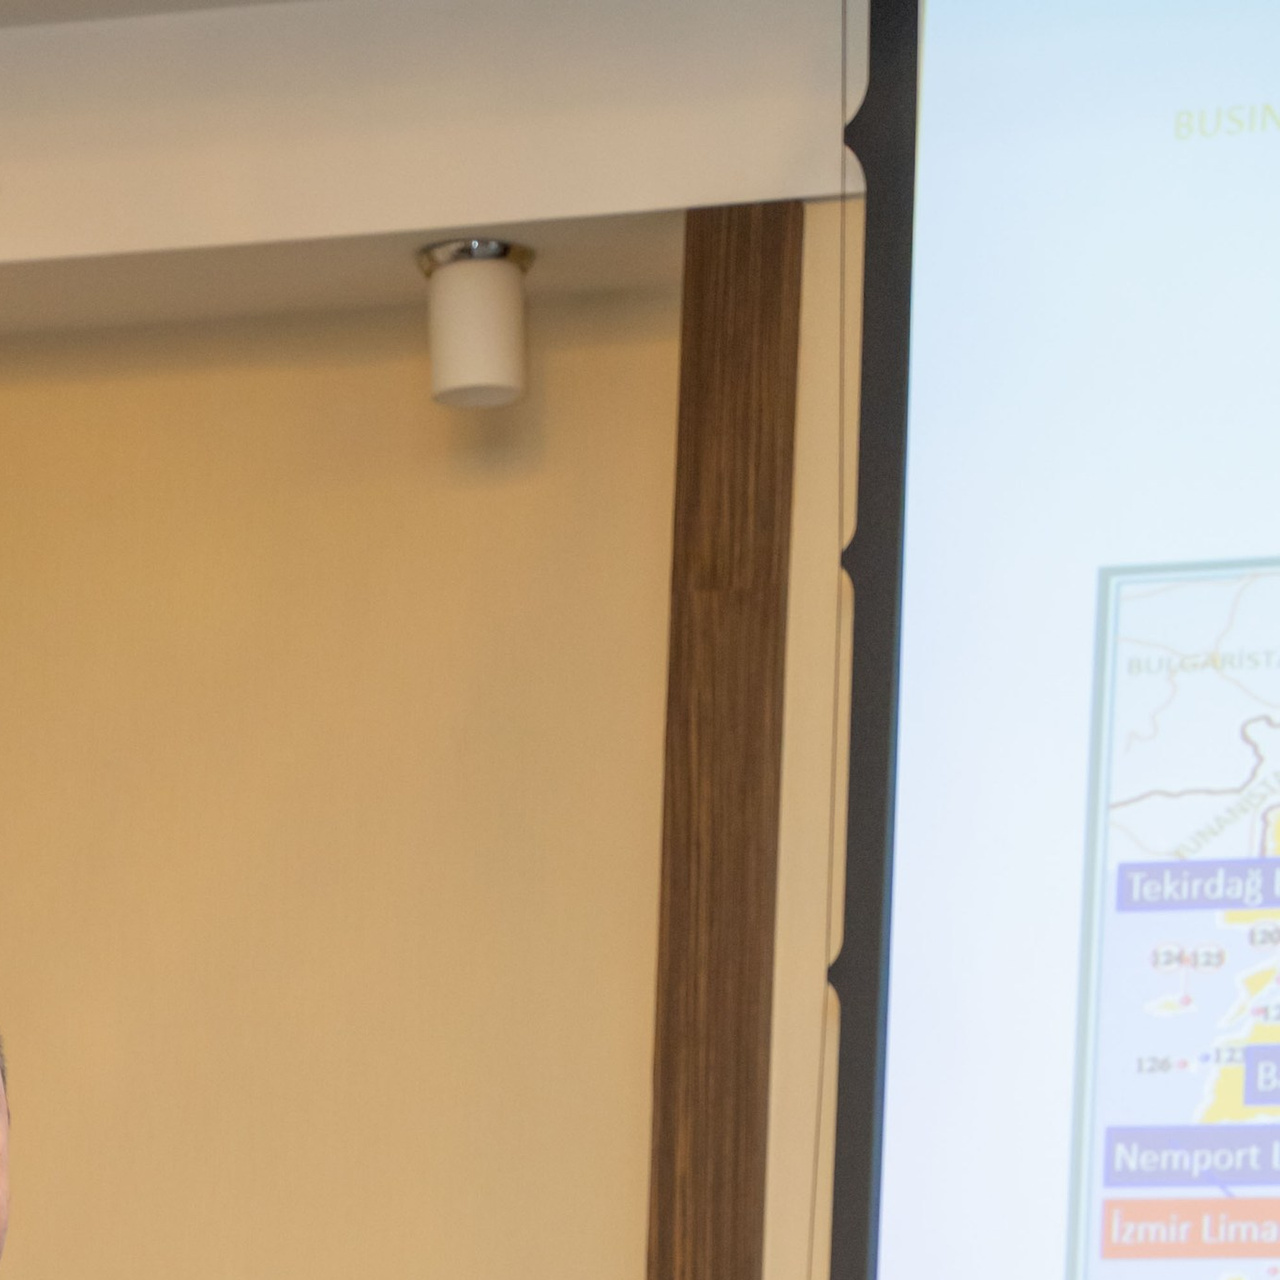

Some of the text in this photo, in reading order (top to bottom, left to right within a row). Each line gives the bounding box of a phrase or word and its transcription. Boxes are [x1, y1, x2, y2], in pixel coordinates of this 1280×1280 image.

[1128, 867, 1263, 906] Tekirdağ
[1114, 1141, 1261, 1178] Nemport
[1202, 1214, 1280, 1244] Lima
